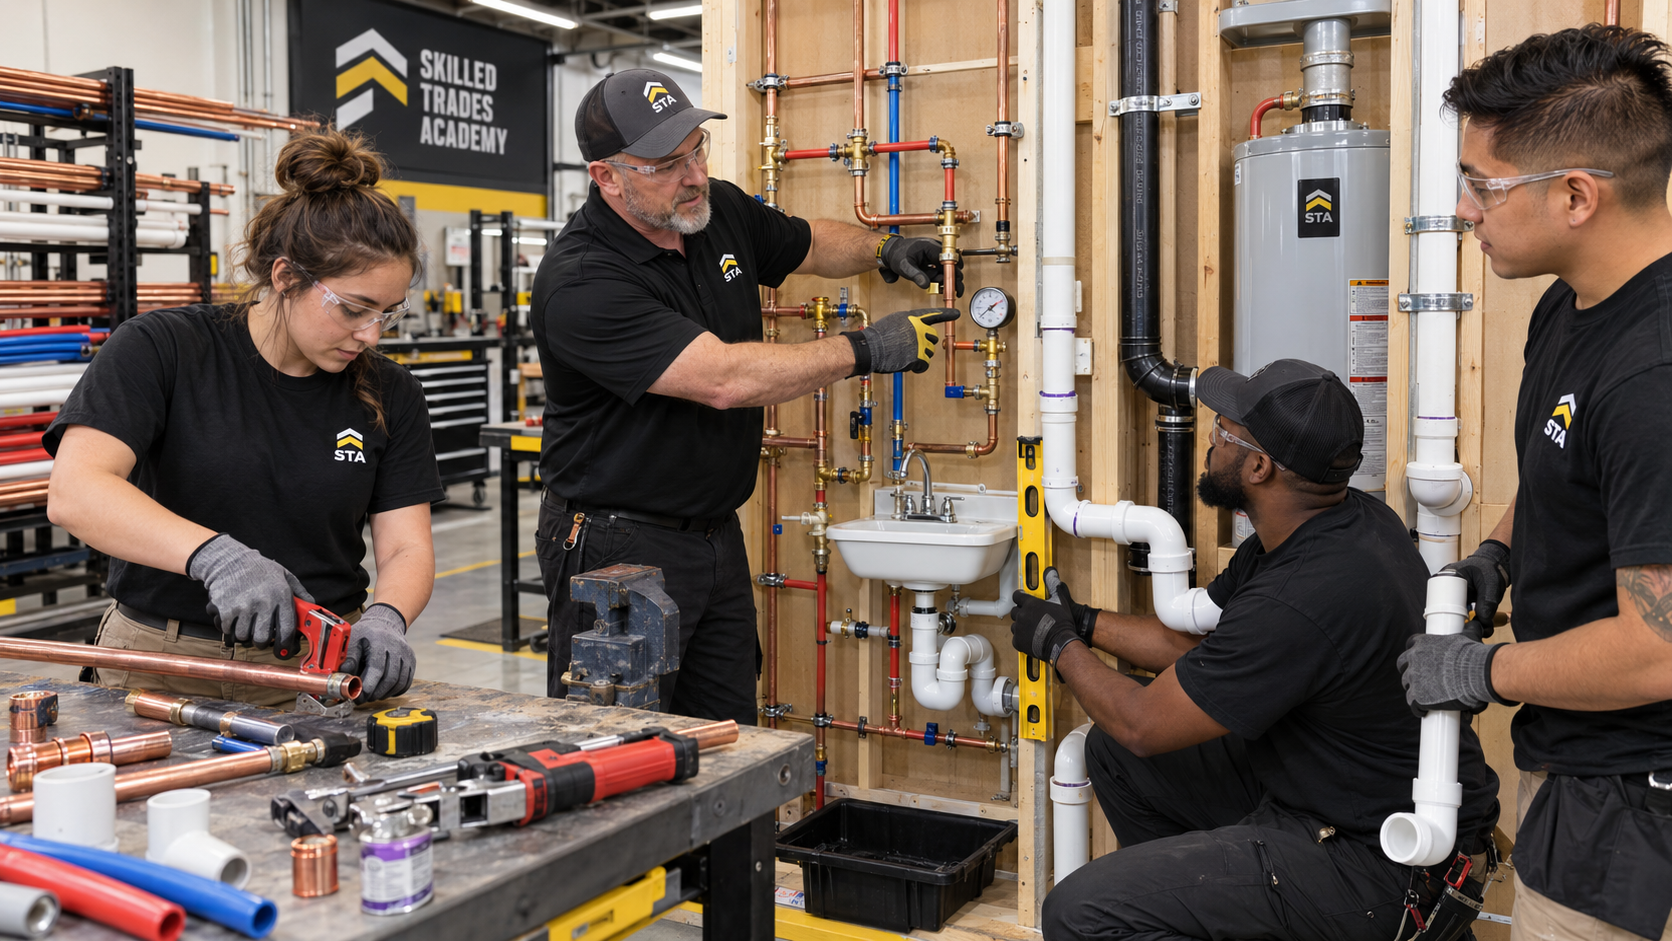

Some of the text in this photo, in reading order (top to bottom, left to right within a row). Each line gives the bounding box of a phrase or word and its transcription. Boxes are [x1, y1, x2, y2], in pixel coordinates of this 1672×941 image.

[420, 49, 497, 92] SKILLED
[420, 82, 494, 123] TRADES
[652, 95, 677, 113] STA
[420, 116, 508, 155] ACADEMY
[1305, 212, 1333, 223] STA
[724, 266, 742, 282] STA
[1544, 419, 1566, 448] STA
[334, 450, 366, 463] STA
